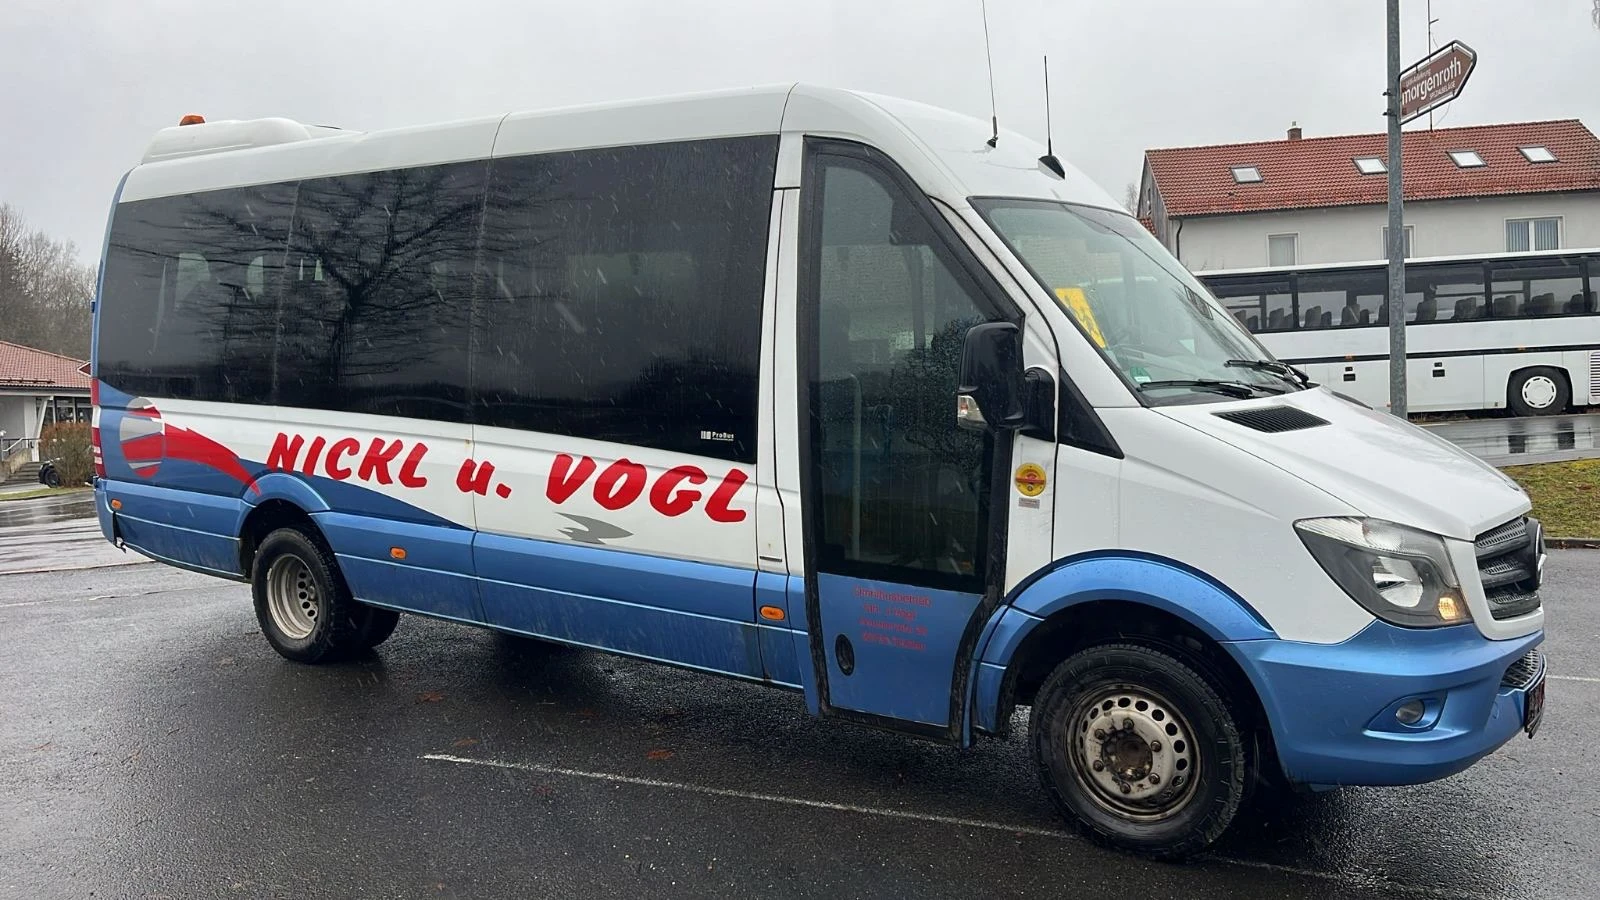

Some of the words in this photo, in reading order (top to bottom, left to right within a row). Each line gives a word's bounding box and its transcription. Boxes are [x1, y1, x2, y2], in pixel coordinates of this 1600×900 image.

[1402, 57, 1461, 105] morgenroth
[266, 432, 428, 489] NICKL
[456, 458, 512, 499] u.
[546, 453, 749, 523] VOGL
